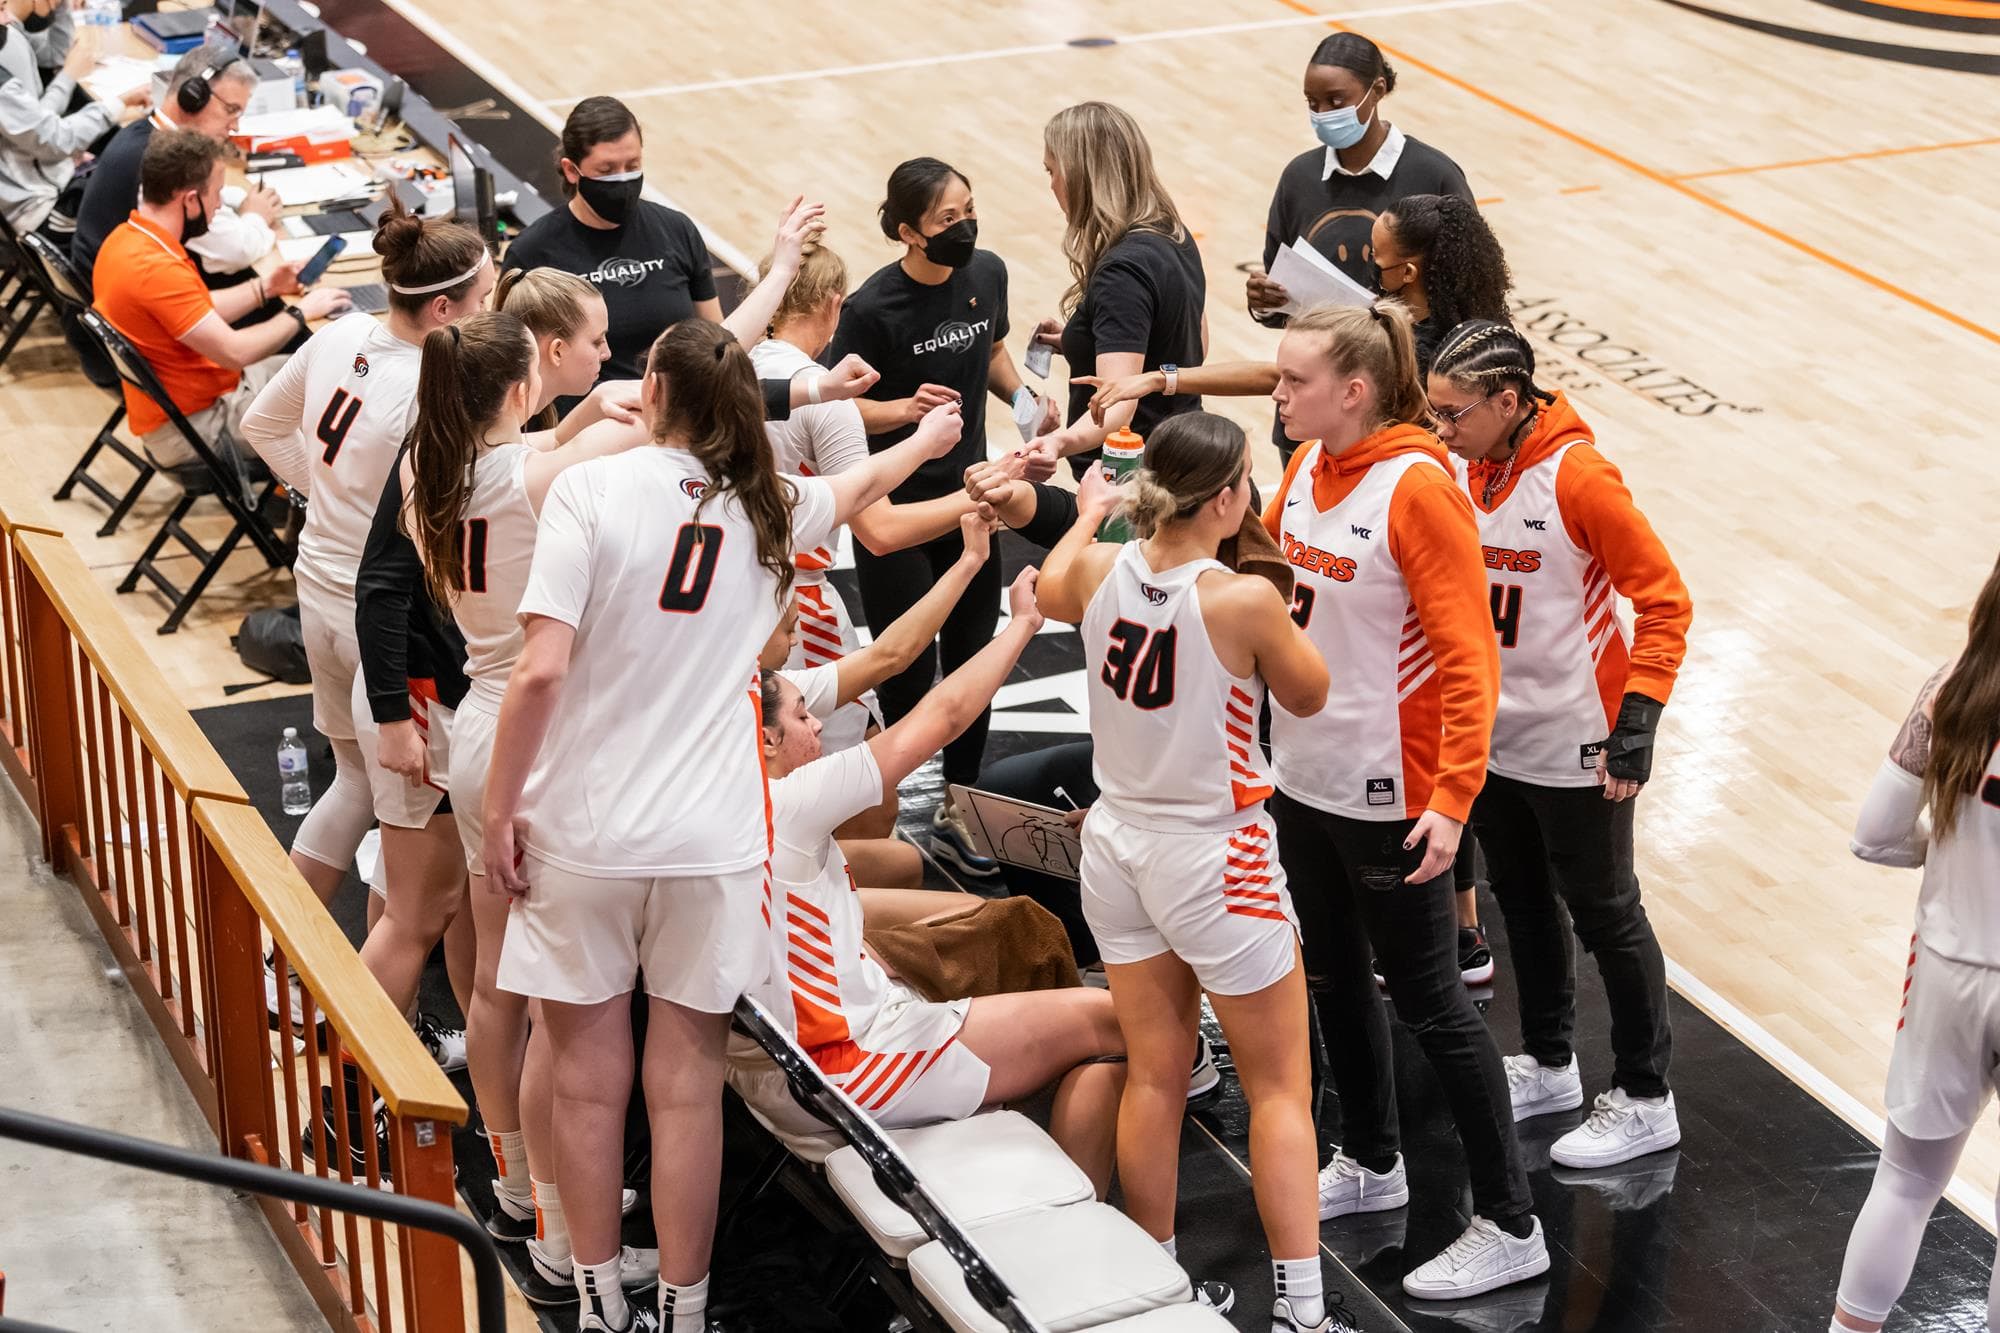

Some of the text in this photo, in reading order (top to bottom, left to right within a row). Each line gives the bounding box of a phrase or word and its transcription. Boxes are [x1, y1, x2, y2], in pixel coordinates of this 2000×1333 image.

[913, 318, 990, 355] EQUALITY
[316, 386, 363, 467] 4
[1351, 524, 1372, 540] WCC
[1523, 518, 1546, 531] WCC
[658, 521, 724, 614] 0
[1101, 616, 1178, 711] 30
[1586, 745, 1600, 754] XL
[1373, 781, 1388, 790] XL
